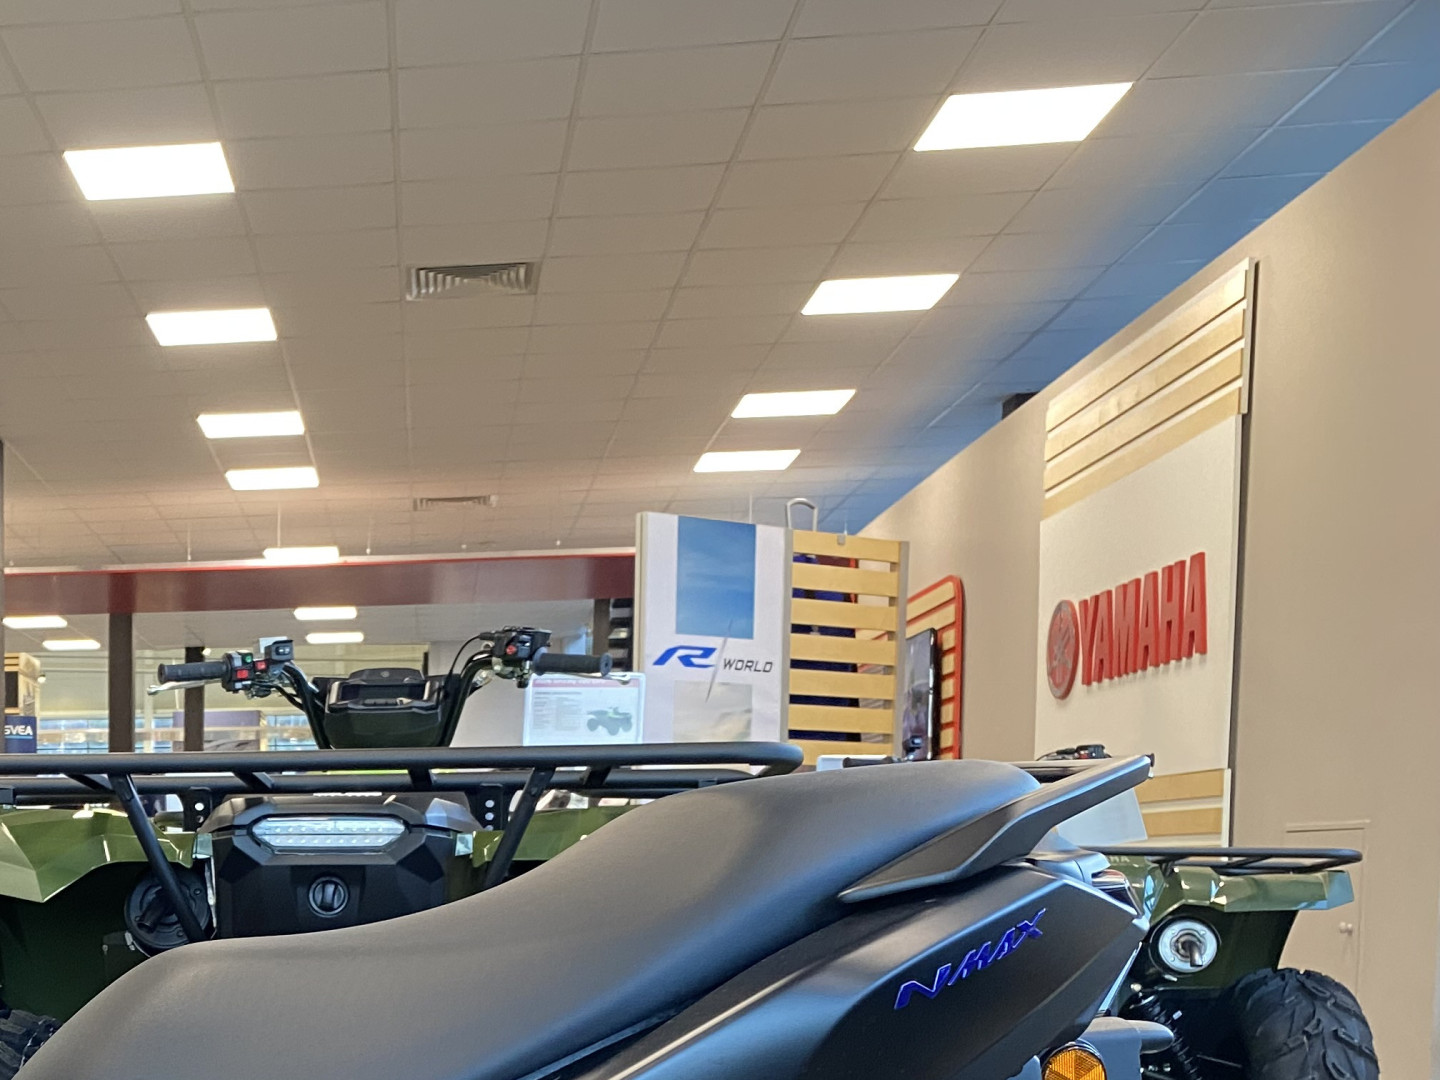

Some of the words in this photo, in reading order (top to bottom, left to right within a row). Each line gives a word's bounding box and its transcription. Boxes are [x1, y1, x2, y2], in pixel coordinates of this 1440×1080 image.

[1078, 551, 1208, 686] YAMAHA
[652, 645, 717, 668] R
[723, 658, 773, 673] WORLD
[4, 725, 34, 736] SVEA
[893, 907, 1048, 1010] NMAX
